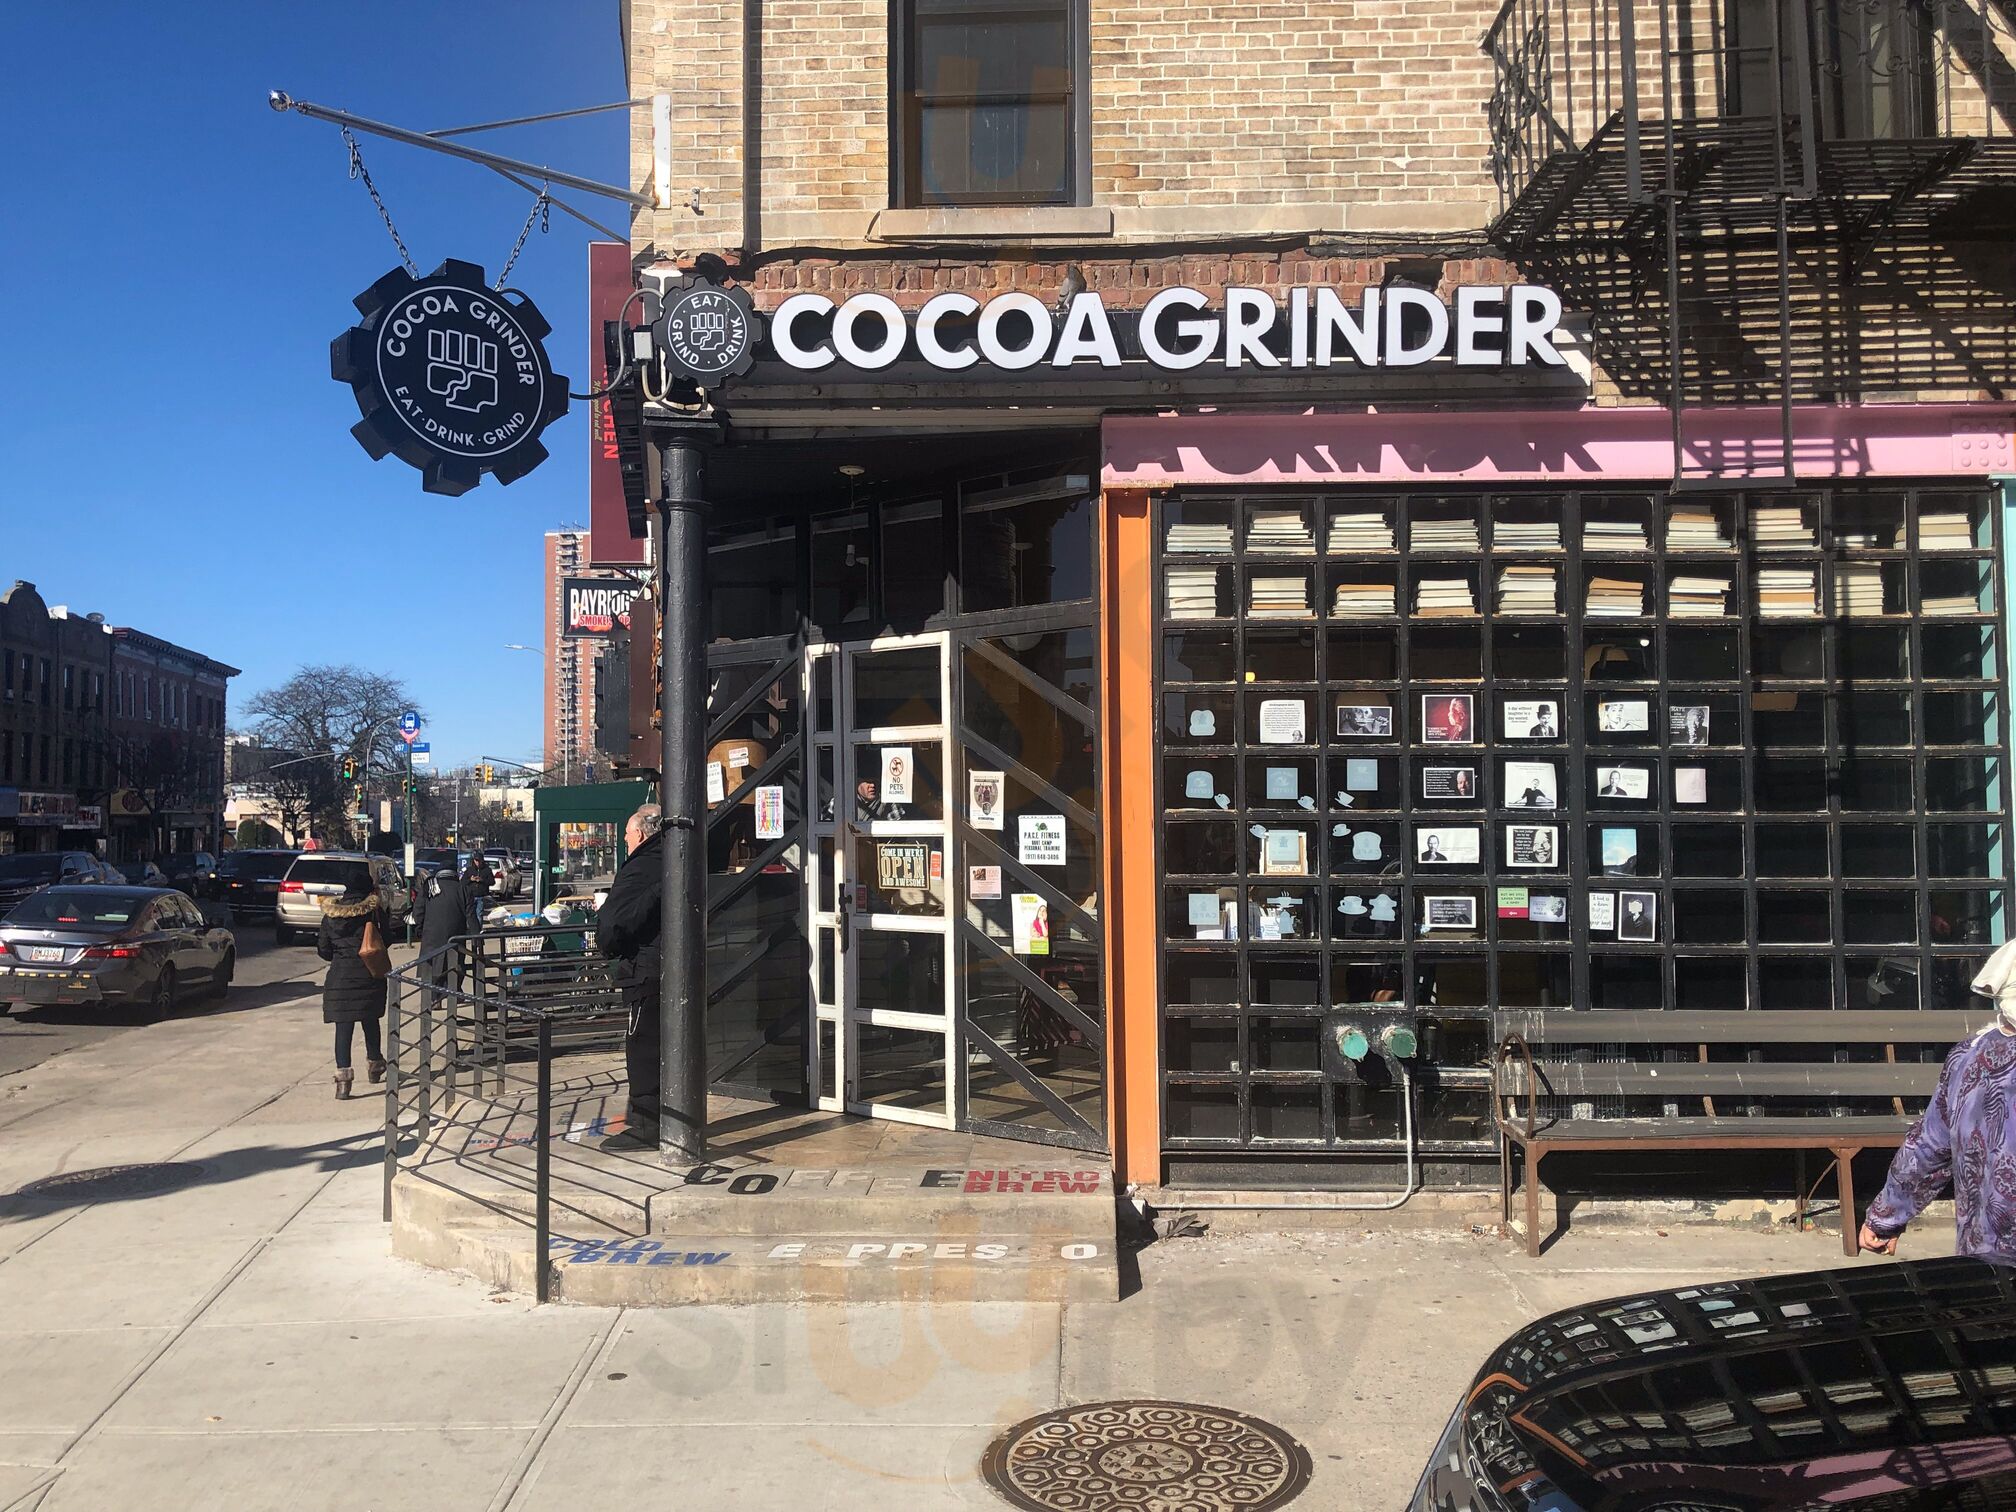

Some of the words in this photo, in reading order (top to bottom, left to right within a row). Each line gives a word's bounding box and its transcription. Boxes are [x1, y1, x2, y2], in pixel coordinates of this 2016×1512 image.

[691, 296, 722, 308] EAT
[771, 292, 1121, 369] COCOA
[1139, 286, 1569, 369] GRINDER
[387, 294, 459, 357] COCOA
[471, 301, 536, 386] GRINDER
[673, 319, 699, 364] GRIND
[718, 318, 742, 364] DRINK
[396, 386, 422, 416] EAT
[424, 419, 475, 447] DRINK
[483, 411, 526, 447] GRIND
[1041, 831, 1060, 839] FITNESS
[881, 848, 897, 857] COME
[897, 848, 904, 856] IN
[881, 857, 925, 879] OPEN
[882, 878, 895, 887] AND
[895, 878, 926, 887] AWESOME
[965, 1170, 1100, 1182] NITRO
[963, 1181, 1099, 1193] BREW
[568, 1250, 731, 1265] BREW
